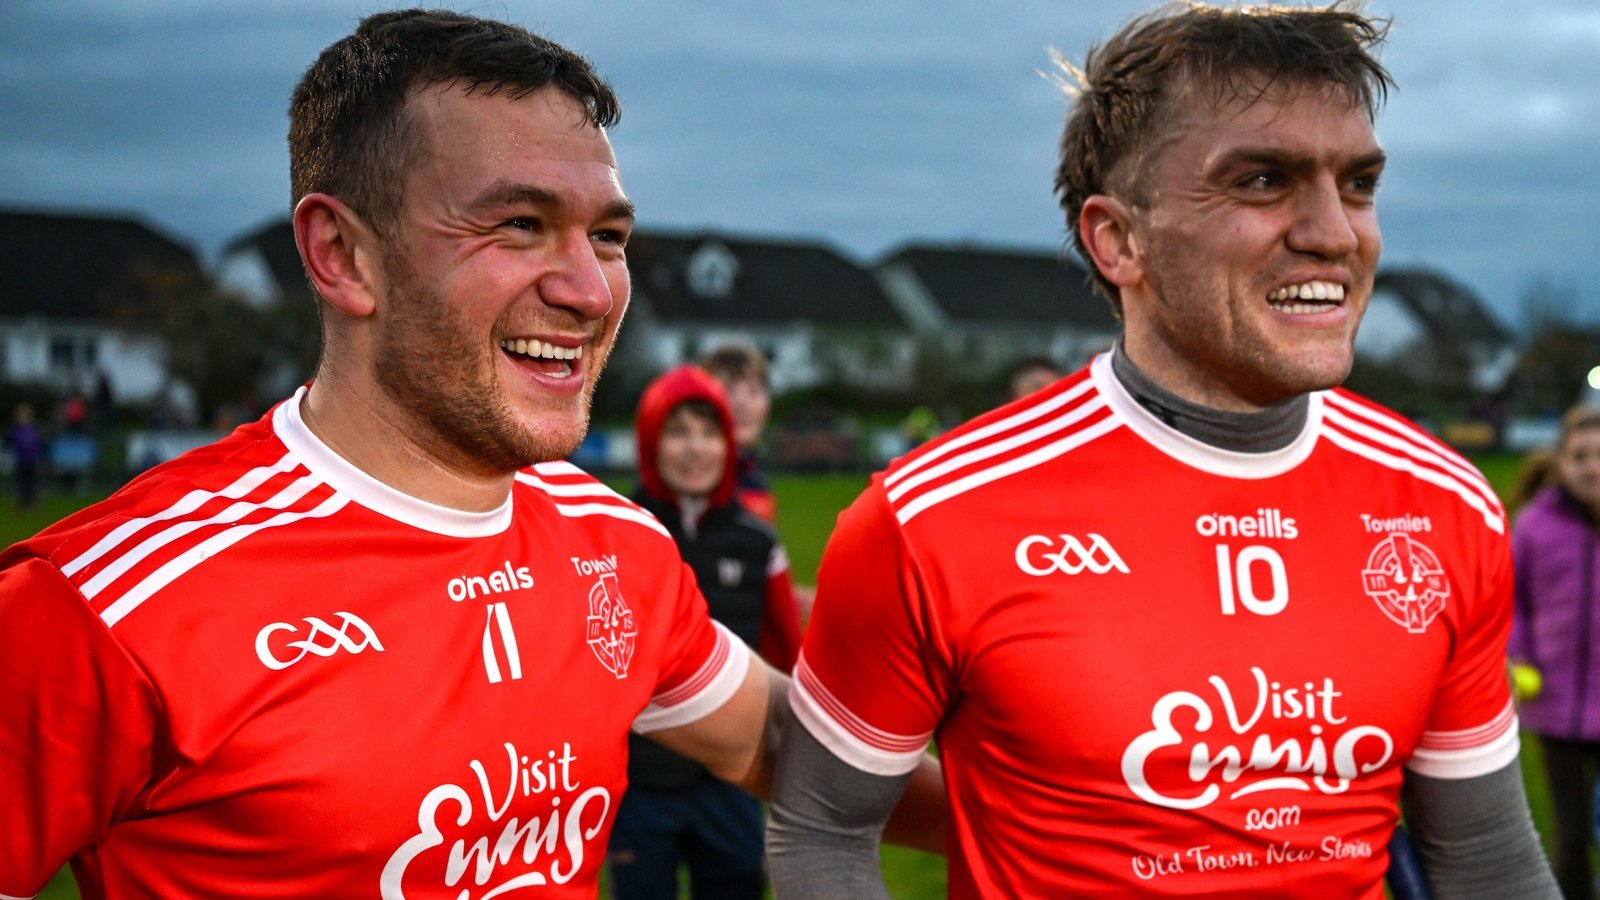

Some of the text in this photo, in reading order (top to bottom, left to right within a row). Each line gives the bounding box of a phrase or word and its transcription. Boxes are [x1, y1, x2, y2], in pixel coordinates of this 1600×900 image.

[1014, 532, 1131, 577] GAA
[1360, 512, 1432, 533] Townies
[1215, 543, 1290, 616] 10
[254, 611, 385, 671] GAA
[482, 601, 523, 684] 11
[1207, 666, 1348, 735] Visit
[469, 741, 581, 822] Visit
[1121, 690, 1394, 810] Ennis
[379, 783, 611, 900] Ennis
[1244, 804, 1301, 831] .com
[1131, 851, 1184, 881] Old
[1266, 840, 1314, 865] New
